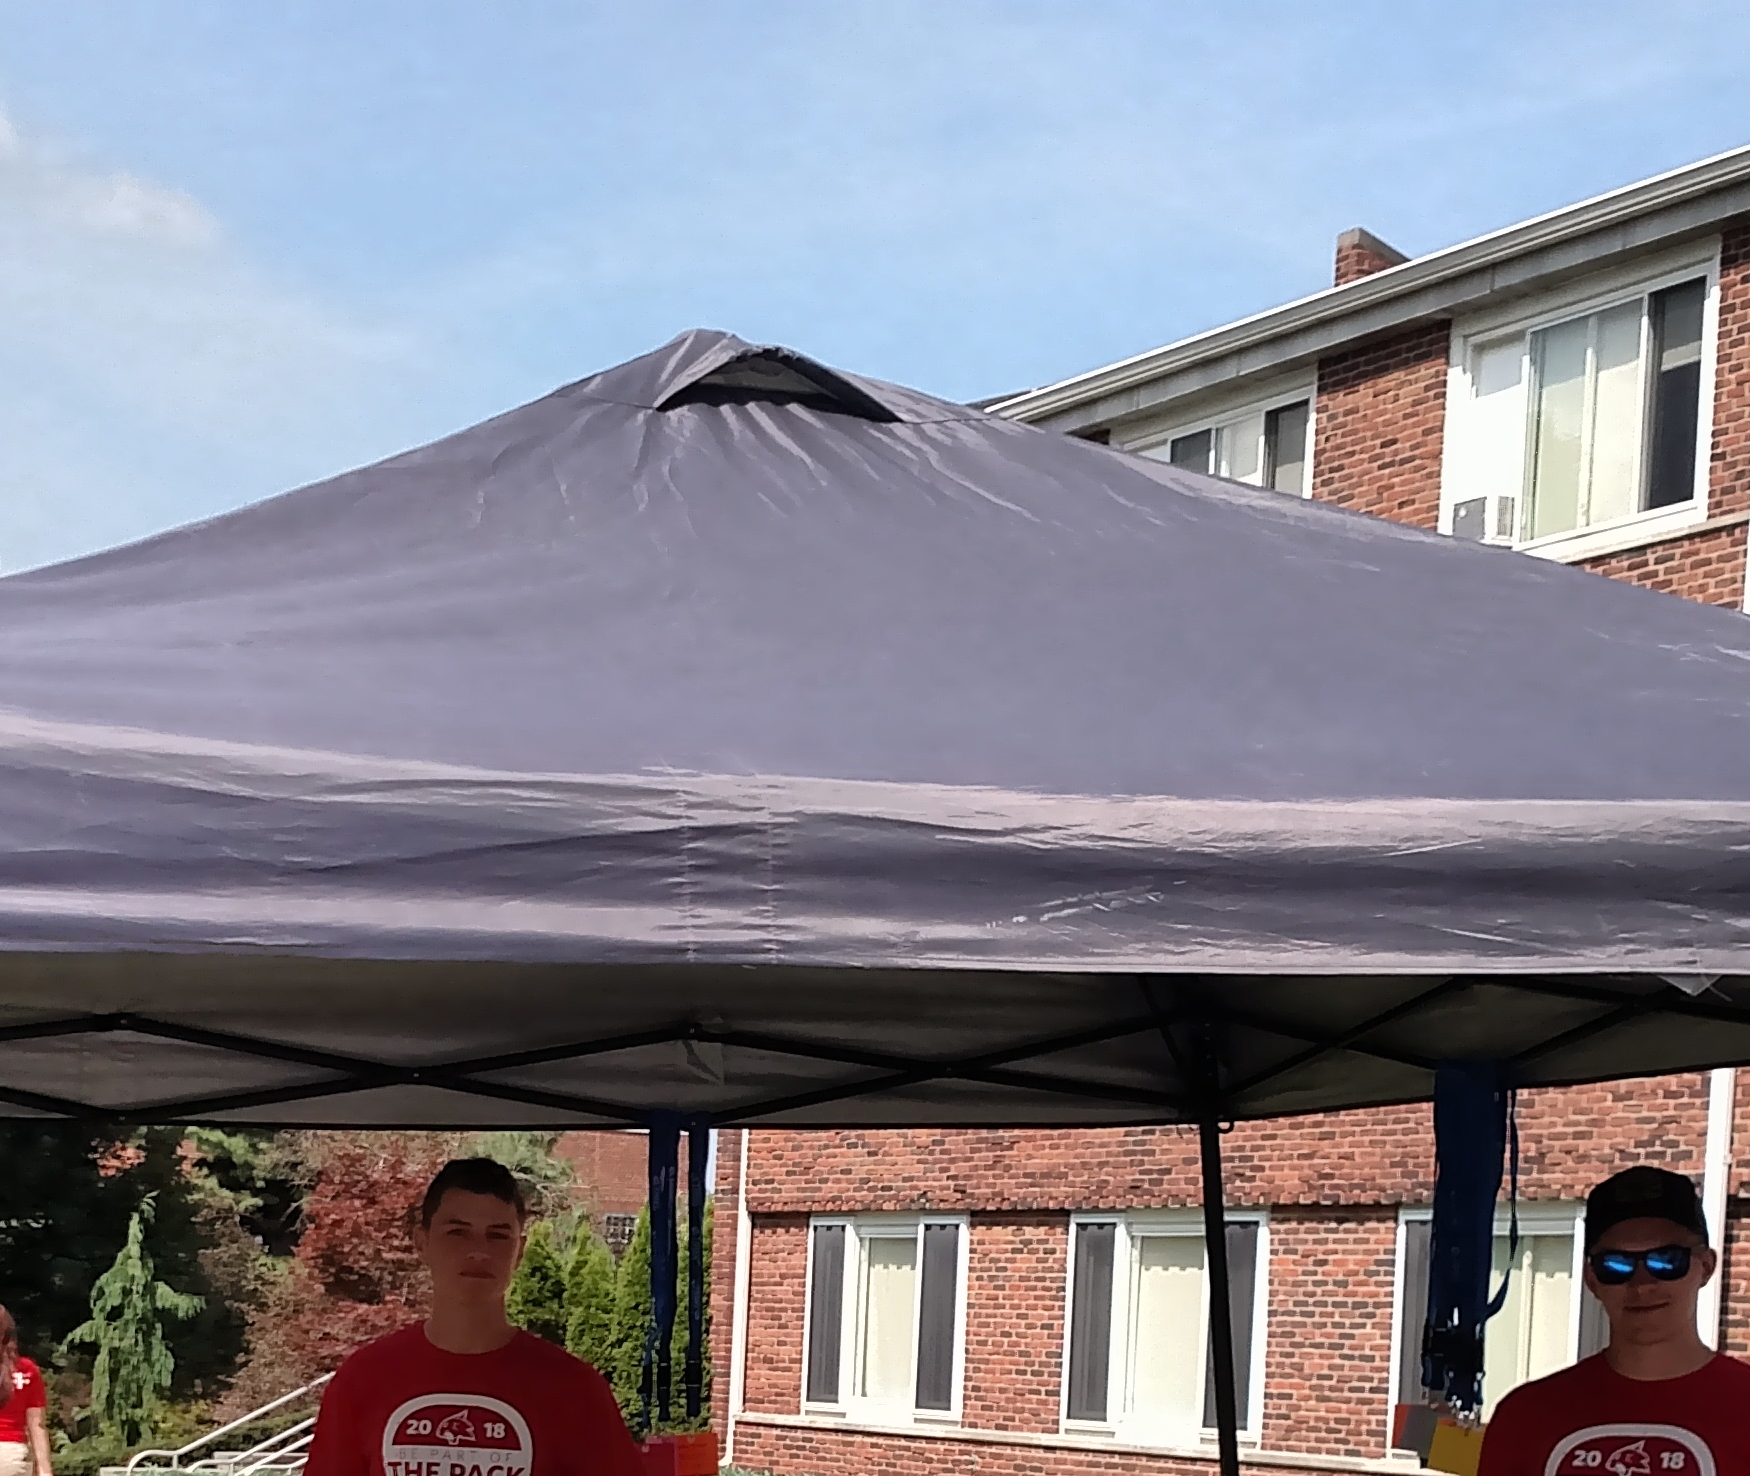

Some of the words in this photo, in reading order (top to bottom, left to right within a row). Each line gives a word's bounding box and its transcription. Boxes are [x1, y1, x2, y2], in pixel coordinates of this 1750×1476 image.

[406, 1420, 432, 1435] 20
[483, 1422, 506, 1438] 18
[1572, 1450, 1602, 1467] 20
[1660, 1451, 1685, 1469] 18
